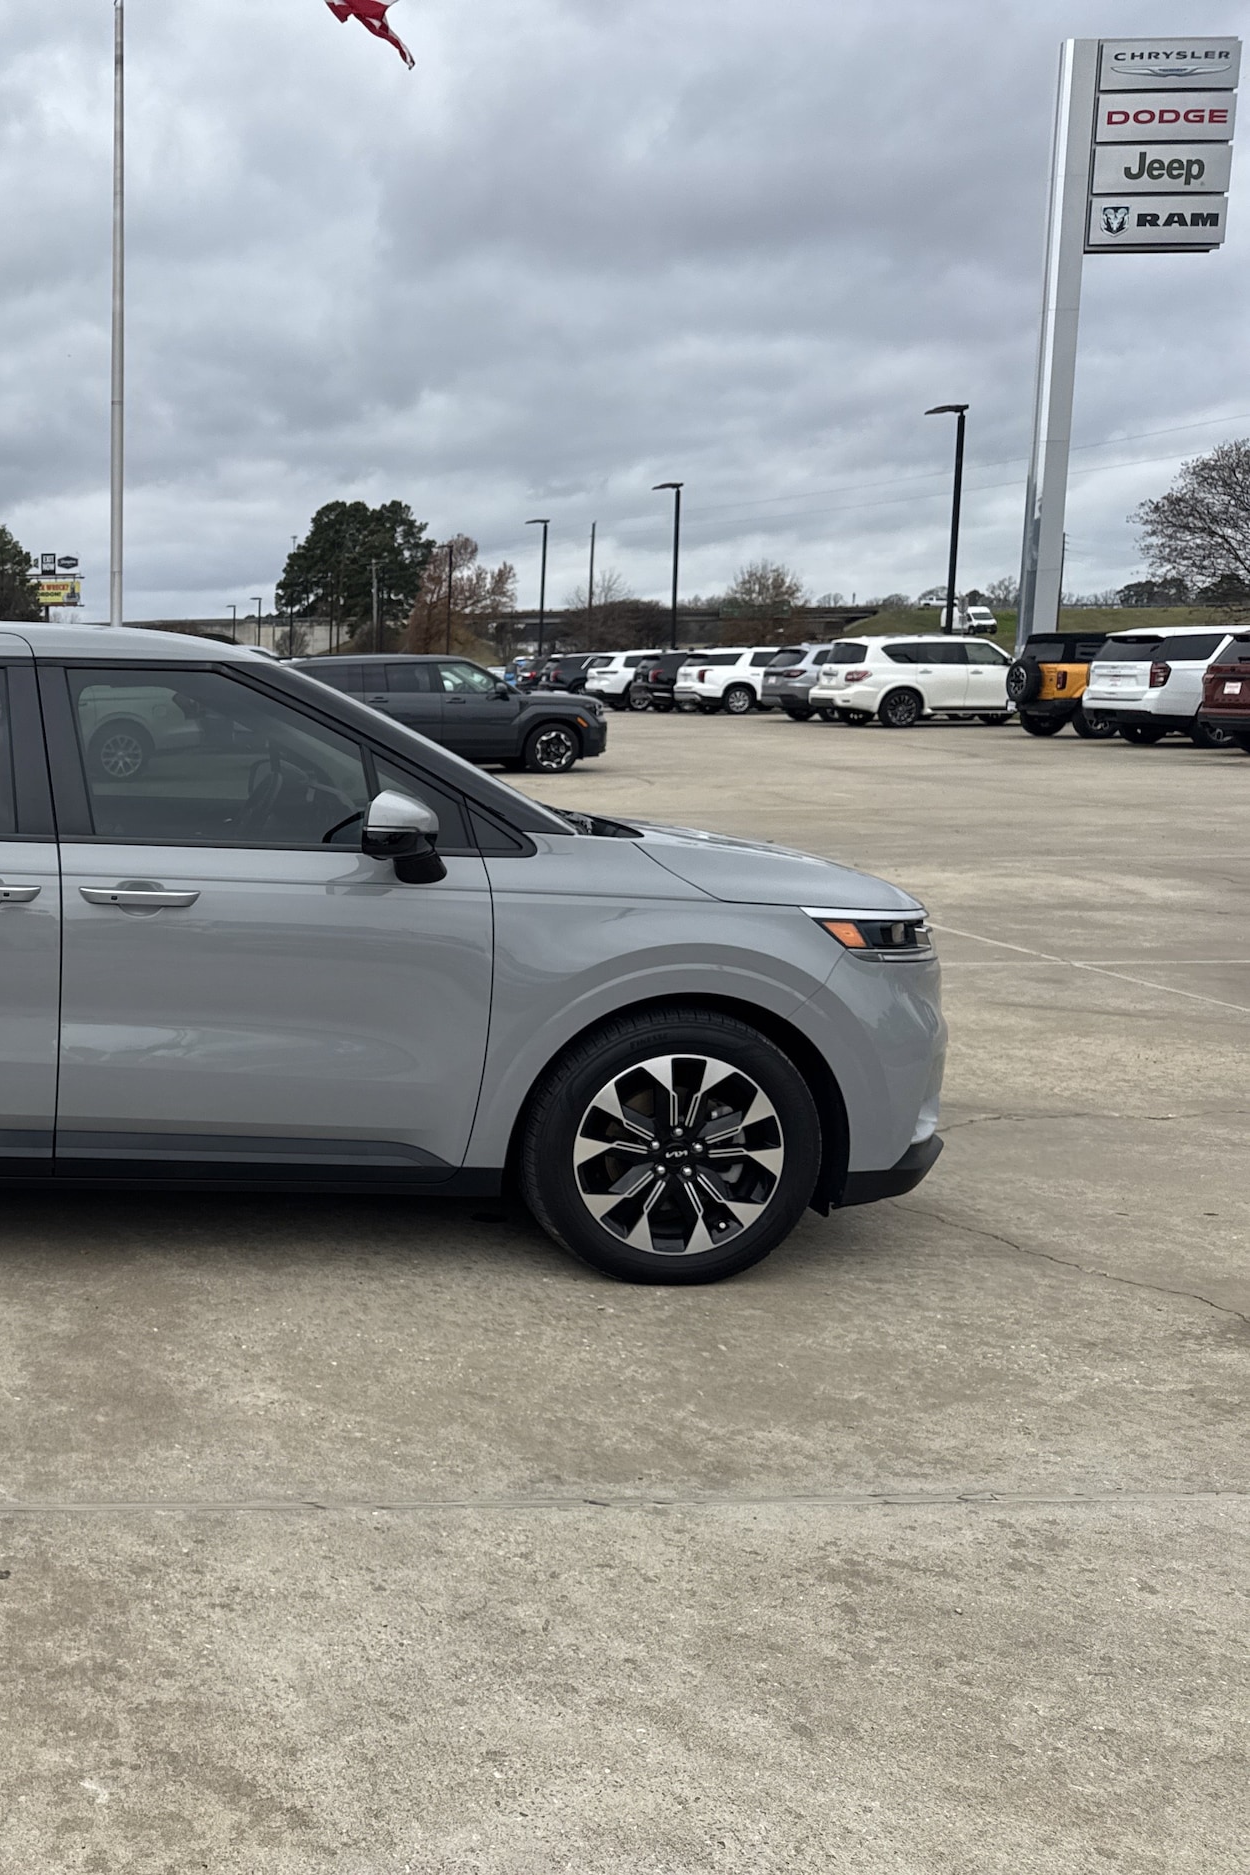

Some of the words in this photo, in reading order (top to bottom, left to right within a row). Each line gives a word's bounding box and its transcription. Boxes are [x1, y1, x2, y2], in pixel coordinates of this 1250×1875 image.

[1114, 50, 1232, 62] CHRYSLER
[1106, 109, 1229, 126] DODGE
[1123, 151, 1206, 186] Jeep
[1136, 212, 1220, 228] RAM
